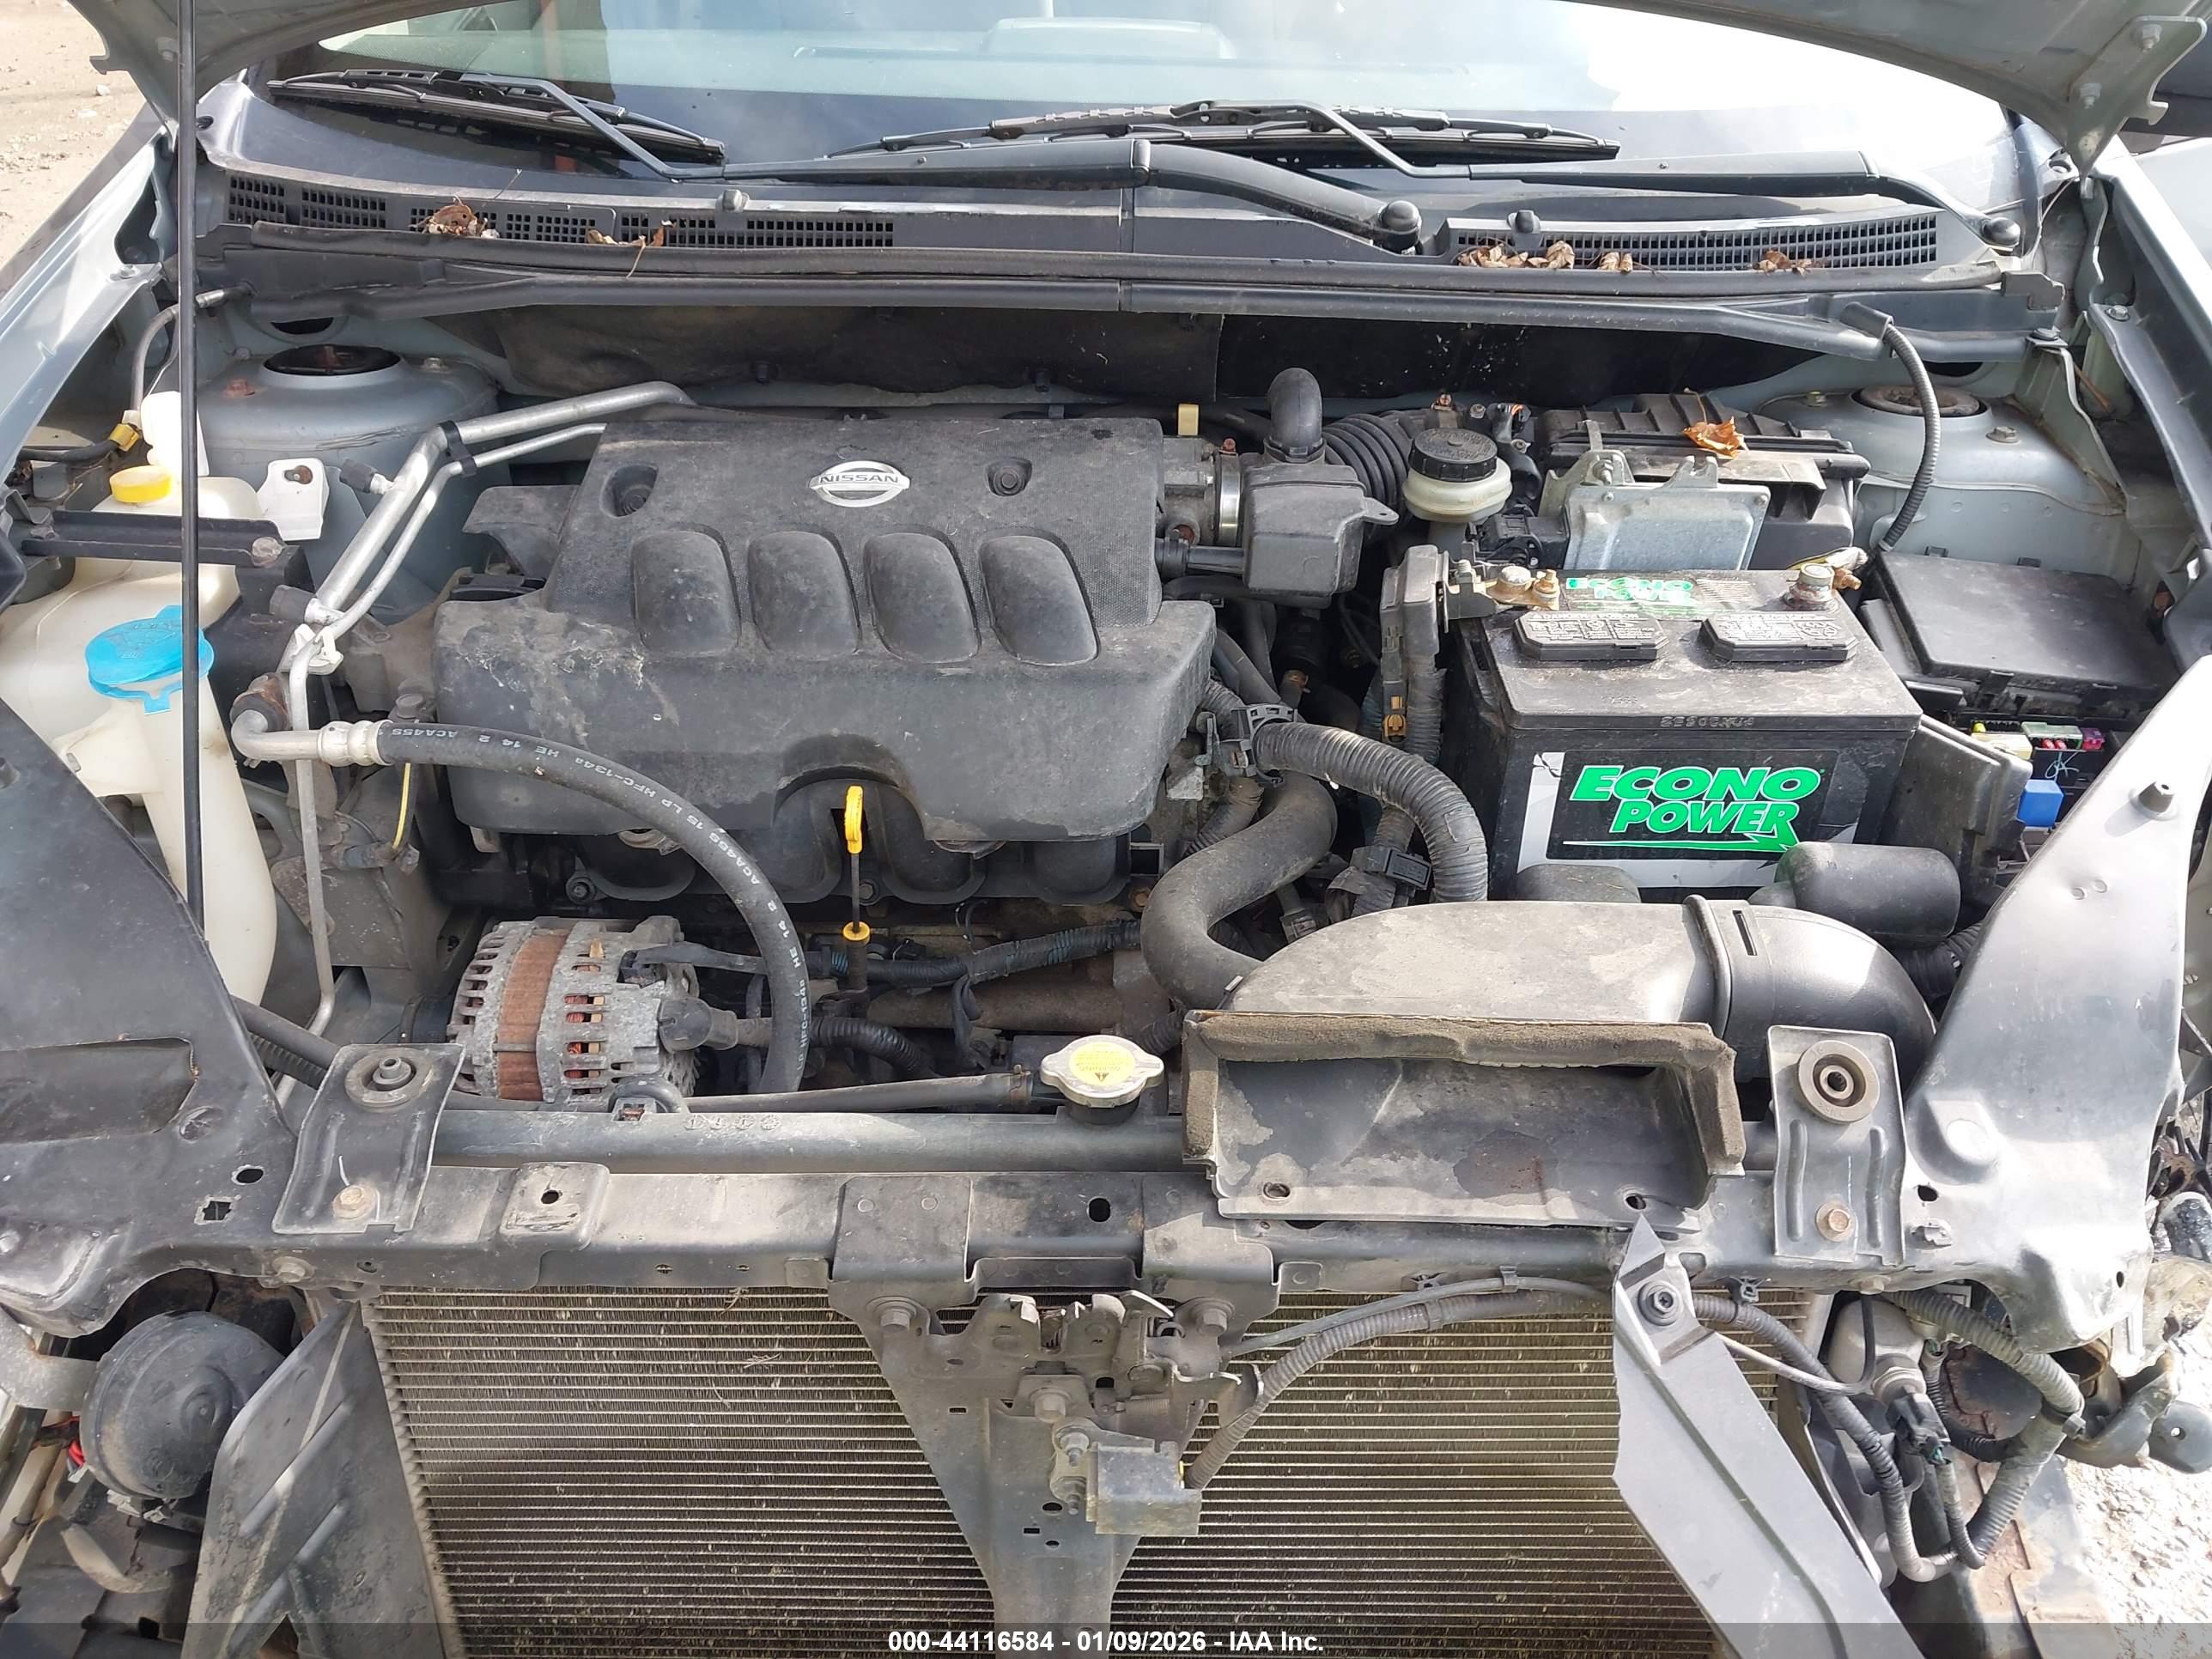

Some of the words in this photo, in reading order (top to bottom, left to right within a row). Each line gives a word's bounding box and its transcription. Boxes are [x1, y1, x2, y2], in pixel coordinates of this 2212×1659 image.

[819, 474, 899, 483] NISSAN
[1566, 577, 1694, 591] ECONO
[392, 728, 459, 738] ACA45S
[501, 738, 521, 749] 14
[534, 745, 560, 757] HE
[574, 757, 657, 799] HFC-134a
[1569, 764, 1821, 802] ECONO
[661, 799, 683, 815] LP
[686, 815, 704, 830] 15
[1608, 799, 1801, 839] POWER
[767, 900, 777, 912] 2
[778, 920, 790, 939] 14
[789, 946, 801, 969] HE
